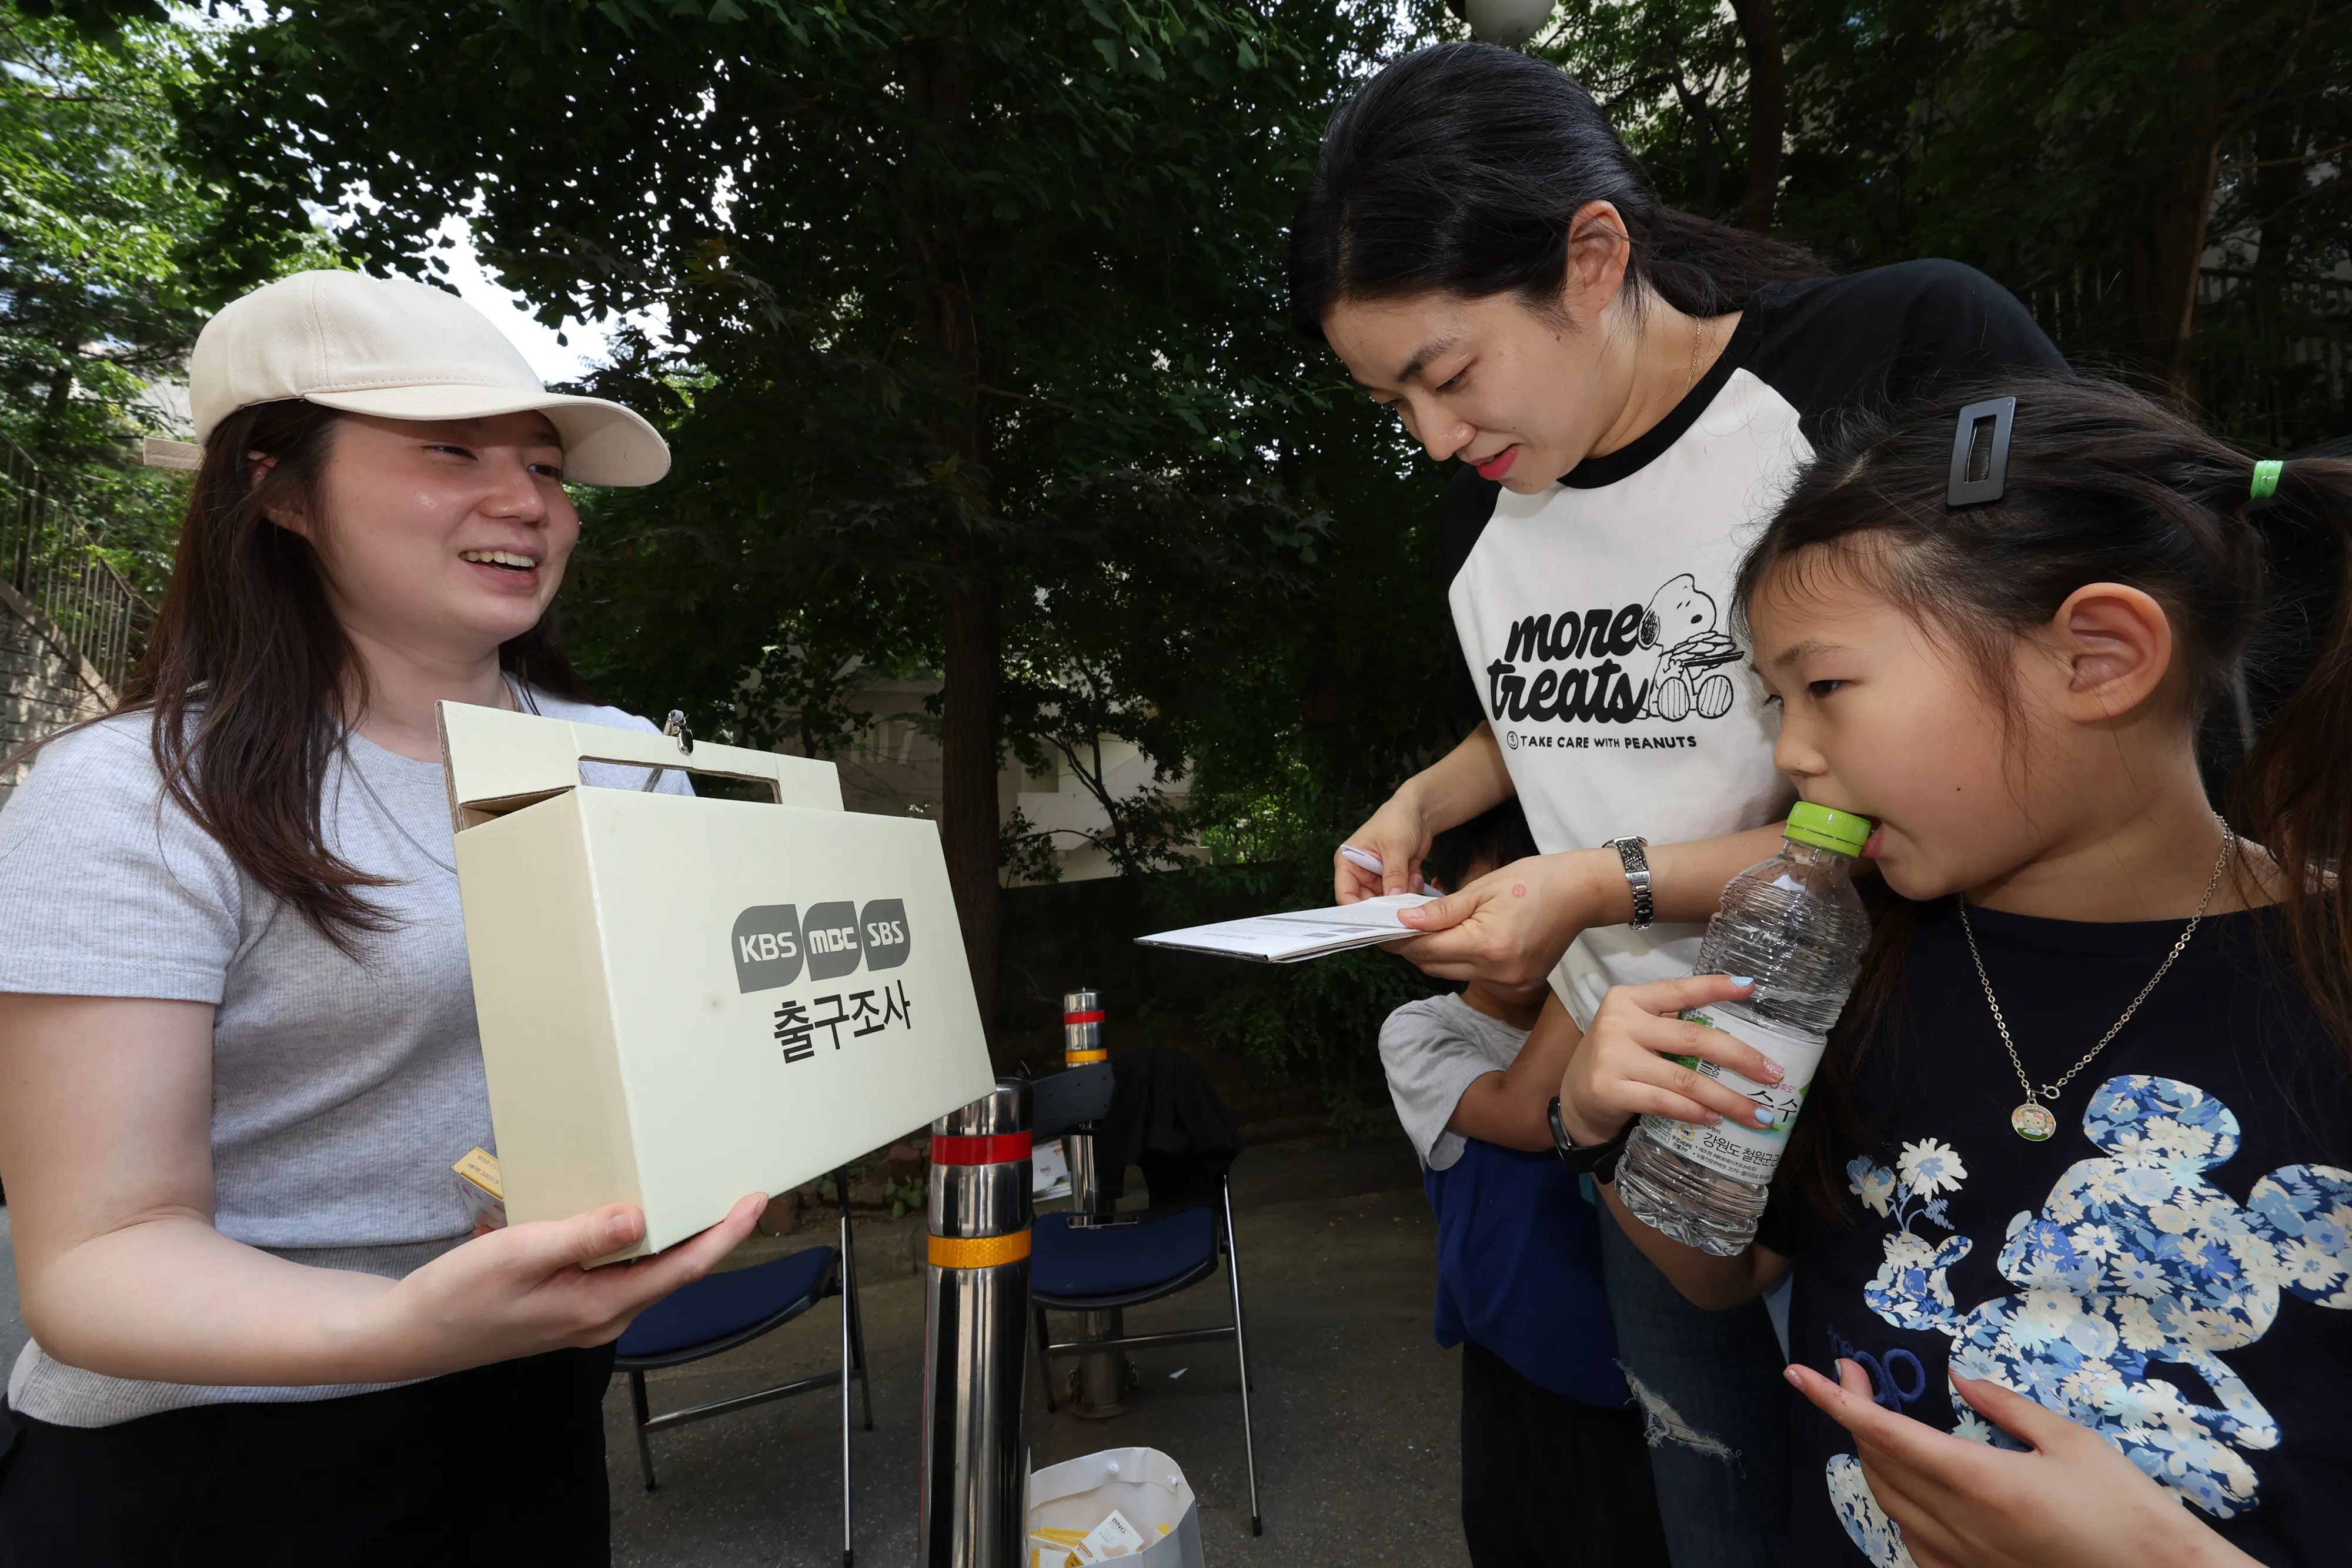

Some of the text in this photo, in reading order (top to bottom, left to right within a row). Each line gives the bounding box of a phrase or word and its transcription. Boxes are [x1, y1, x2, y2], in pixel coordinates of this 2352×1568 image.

[1504, 603, 1645, 662] more
[1487, 658, 1648, 724] treats
[1521, 735, 1552, 748] TAKE
[1557, 736, 1589, 748] CARE
[1625, 735, 1697, 749] PEANUTS
[739, 920, 904, 964] KBS MBC SBS
[774, 979, 911, 1064] 출구조사
[1703, 1132, 1742, 1157] 강원도
[1112, 1517, 1127, 1534] BNG
